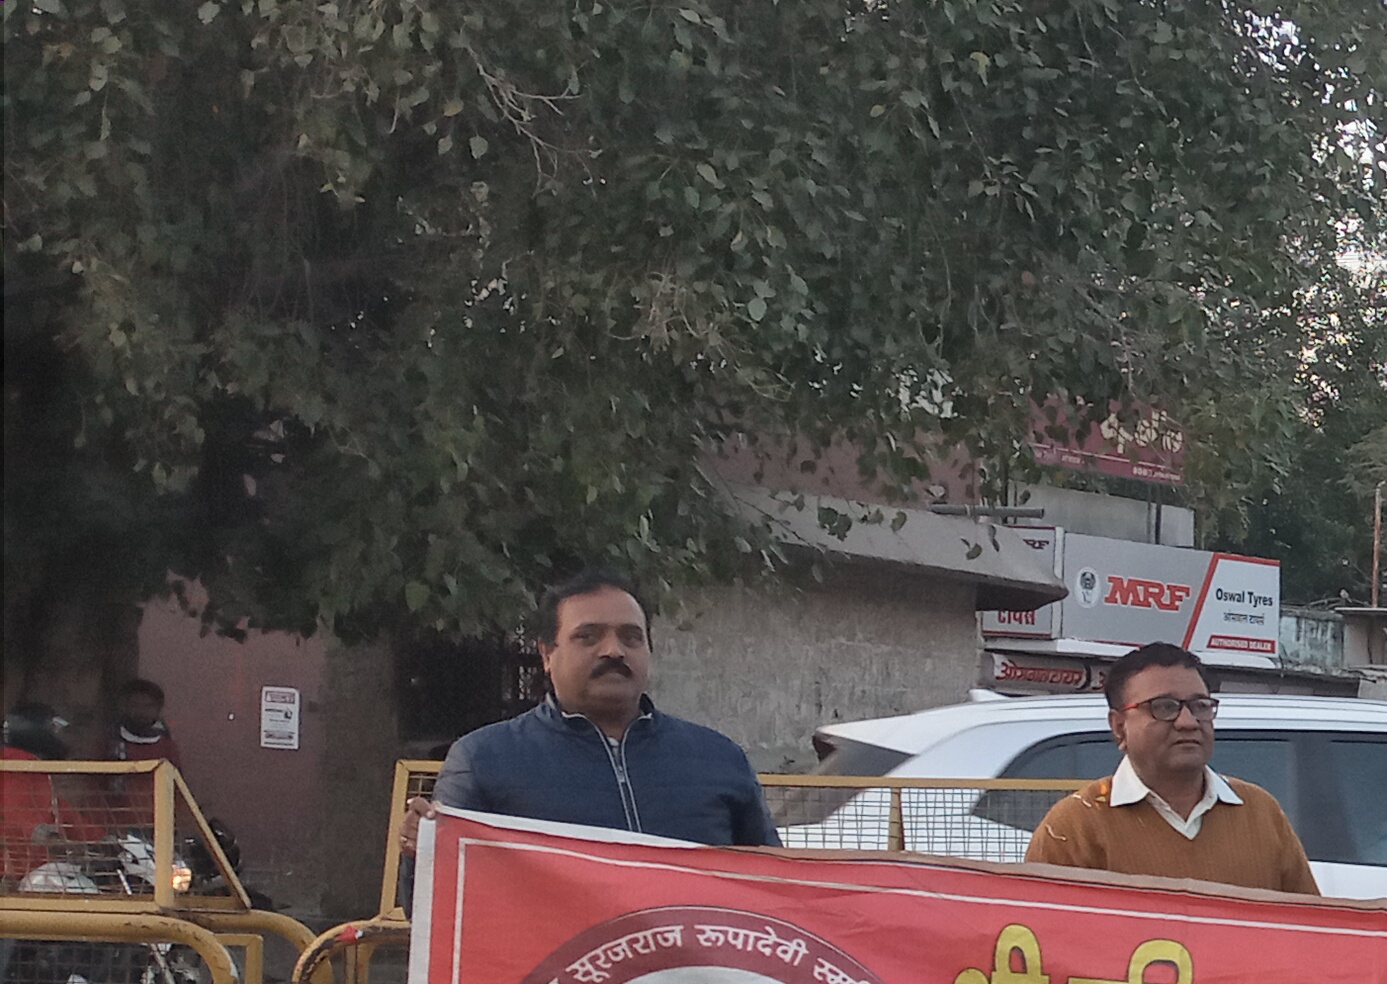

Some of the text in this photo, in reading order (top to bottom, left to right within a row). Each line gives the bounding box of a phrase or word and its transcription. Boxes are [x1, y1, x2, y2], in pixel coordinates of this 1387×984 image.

[1022, 538, 1050, 550] RF
[1104, 575, 1190, 611] MRF
[1216, 588, 1273, 608] Oswal Tyres
[566, 924, 685, 984] सूरजराज
[695, 924, 810, 967] रूपादेवी
